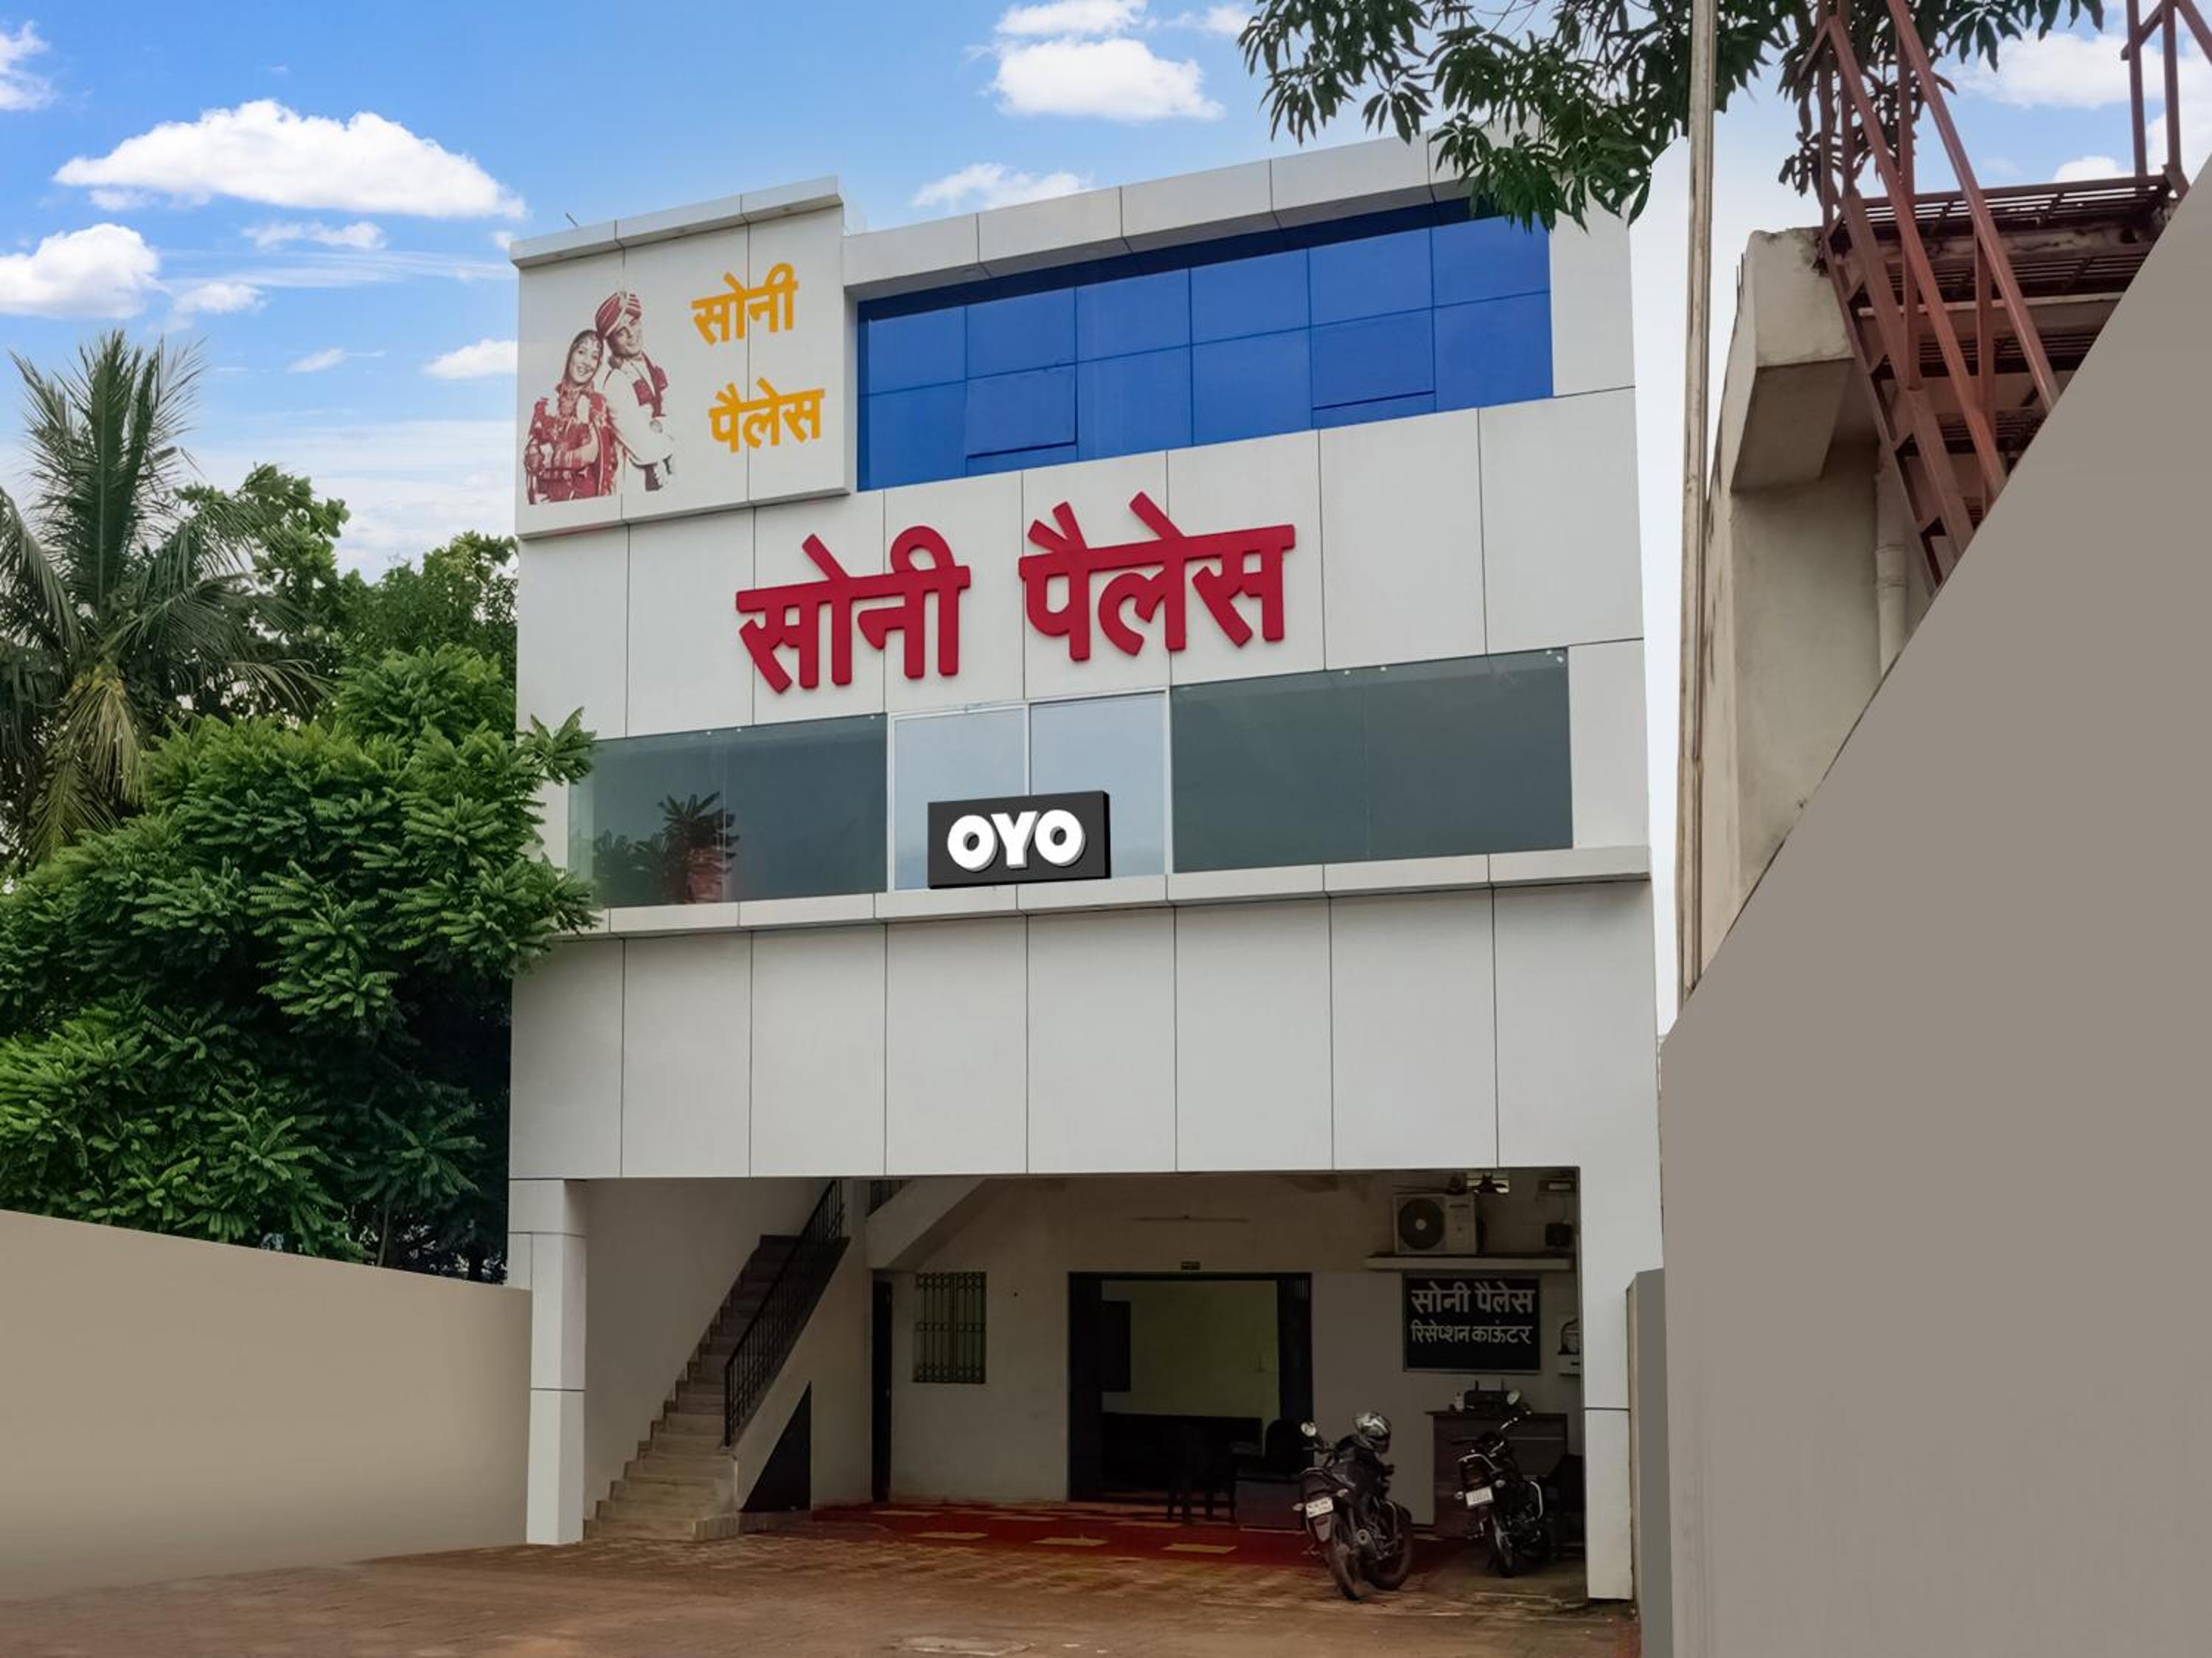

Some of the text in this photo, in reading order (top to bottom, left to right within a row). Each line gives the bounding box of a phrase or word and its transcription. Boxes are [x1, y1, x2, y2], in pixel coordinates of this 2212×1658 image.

[691, 263, 799, 346] सोनी
[708, 377, 825, 454] पैलेस
[736, 490, 1295, 694] सोनी पैलेस
[947, 809, 1086, 873] OYO
[1410, 1319, 1471, 1344] रिसेप्शन
[1411, 1280, 1535, 1314] सोनी पैलेस
